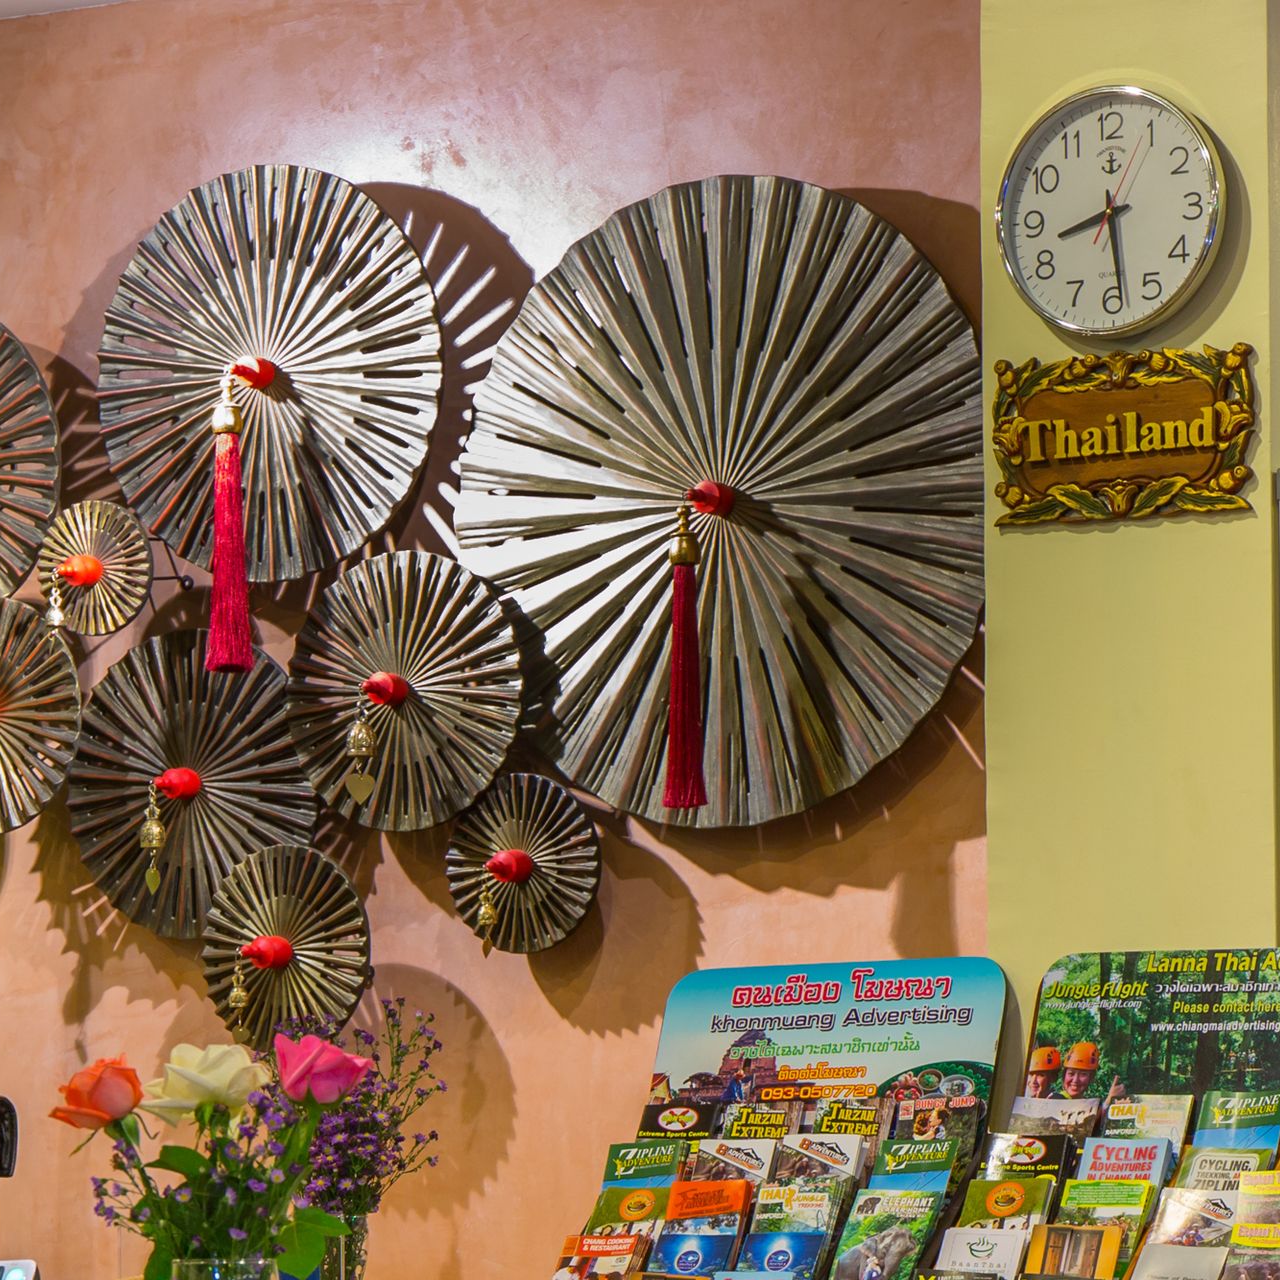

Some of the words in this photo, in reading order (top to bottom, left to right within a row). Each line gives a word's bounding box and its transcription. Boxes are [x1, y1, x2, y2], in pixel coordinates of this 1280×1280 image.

[1097, 112, 1125, 141] 12
[1146, 119, 1154, 147] 1
[1060, 131, 1081, 159] 11
[1169, 146, 1190, 176] 2
[1031, 163, 1060, 195] 10
[1182, 191, 1203, 221] 3
[1023, 210, 1045, 239] 9
[1167, 234, 1191, 264] 4
[1035, 250, 1055, 280] 8
[1066, 279, 1085, 307] 7
[1102, 285, 1123, 315] 6
[1141, 272, 1163, 301] 5
[1020, 407, 1216, 463] Thailand
[1147, 952, 1208, 974] Lanna
[1214, 951, 1258, 973] Thai
[731, 973, 841, 1008] คนเมือง
[850, 967, 952, 1001] โฆษณา
[710, 1012, 837, 1032] khonmuang
[841, 1005, 974, 1027] Advertising
[1172, 1001, 1209, 1013] Please
[1212, 1002, 1254, 1013] contact
[777, 1062, 867, 1081] ติดต่อโฆษณา
[761, 1084, 877, 1101] 093-0507720
[949, 1096, 976, 1108] JUMP
[740, 1107, 785, 1125] TARZAN
[831, 1103, 876, 1122] TARZAN
[731, 1123, 788, 1138] EXTREME
[821, 1120, 879, 1135] EXTREME
[1092, 1144, 1158, 1161] CYCLING
[1199, 1159, 1251, 1172] CYCLING,
[1090, 1161, 1152, 1172] ADVENTURES
[1192, 1181, 1239, 1191] ZIPLIN
